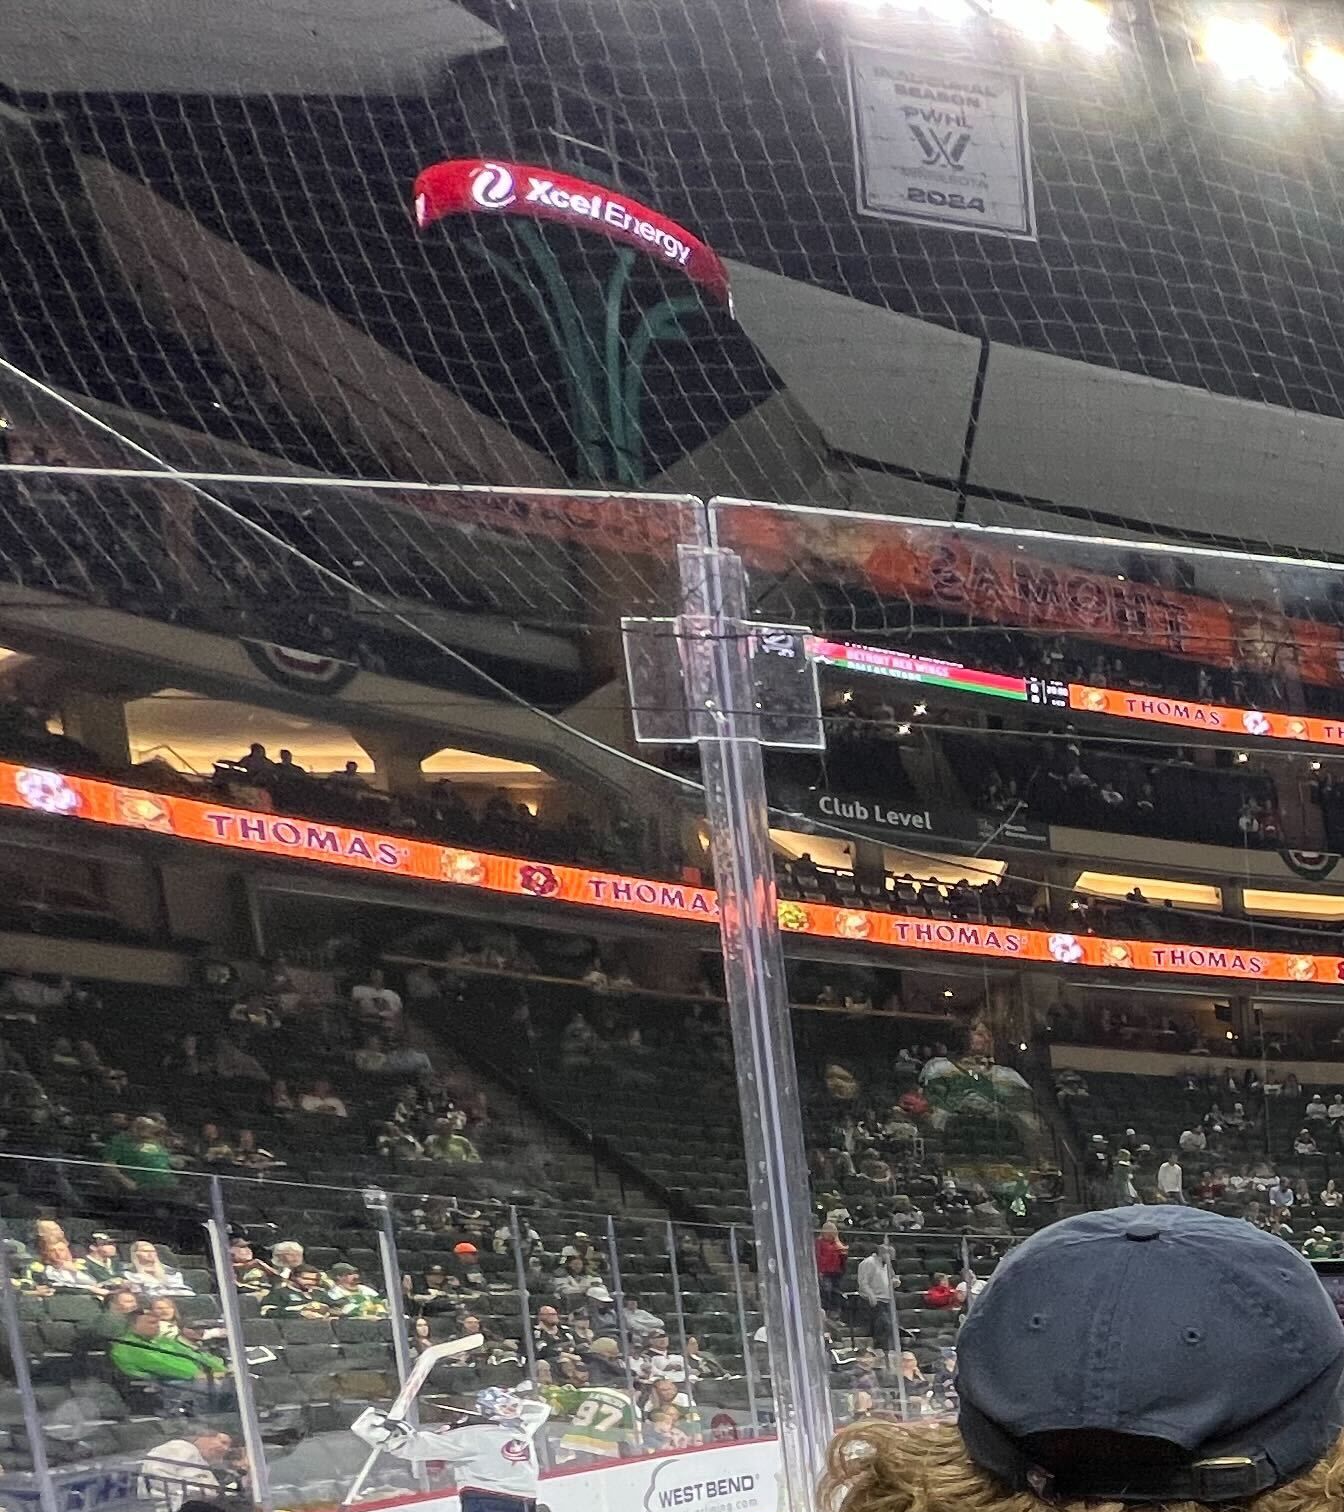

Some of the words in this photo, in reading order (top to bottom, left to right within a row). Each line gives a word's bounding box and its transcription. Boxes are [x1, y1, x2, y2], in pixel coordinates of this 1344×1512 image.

[1124, 698, 1221, 727] THOMAS
[818, 796, 869, 820] Club
[874, 804, 932, 830] Level
[206, 813, 401, 867] THOMAS
[895, 922, 1022, 952] THOMAS
[1152, 949, 1263, 974] THOMAS
[572, 1400, 623, 1432] 97
[658, 1483, 703, 1508] WEST
[706, 1475, 754, 1498] BEND
